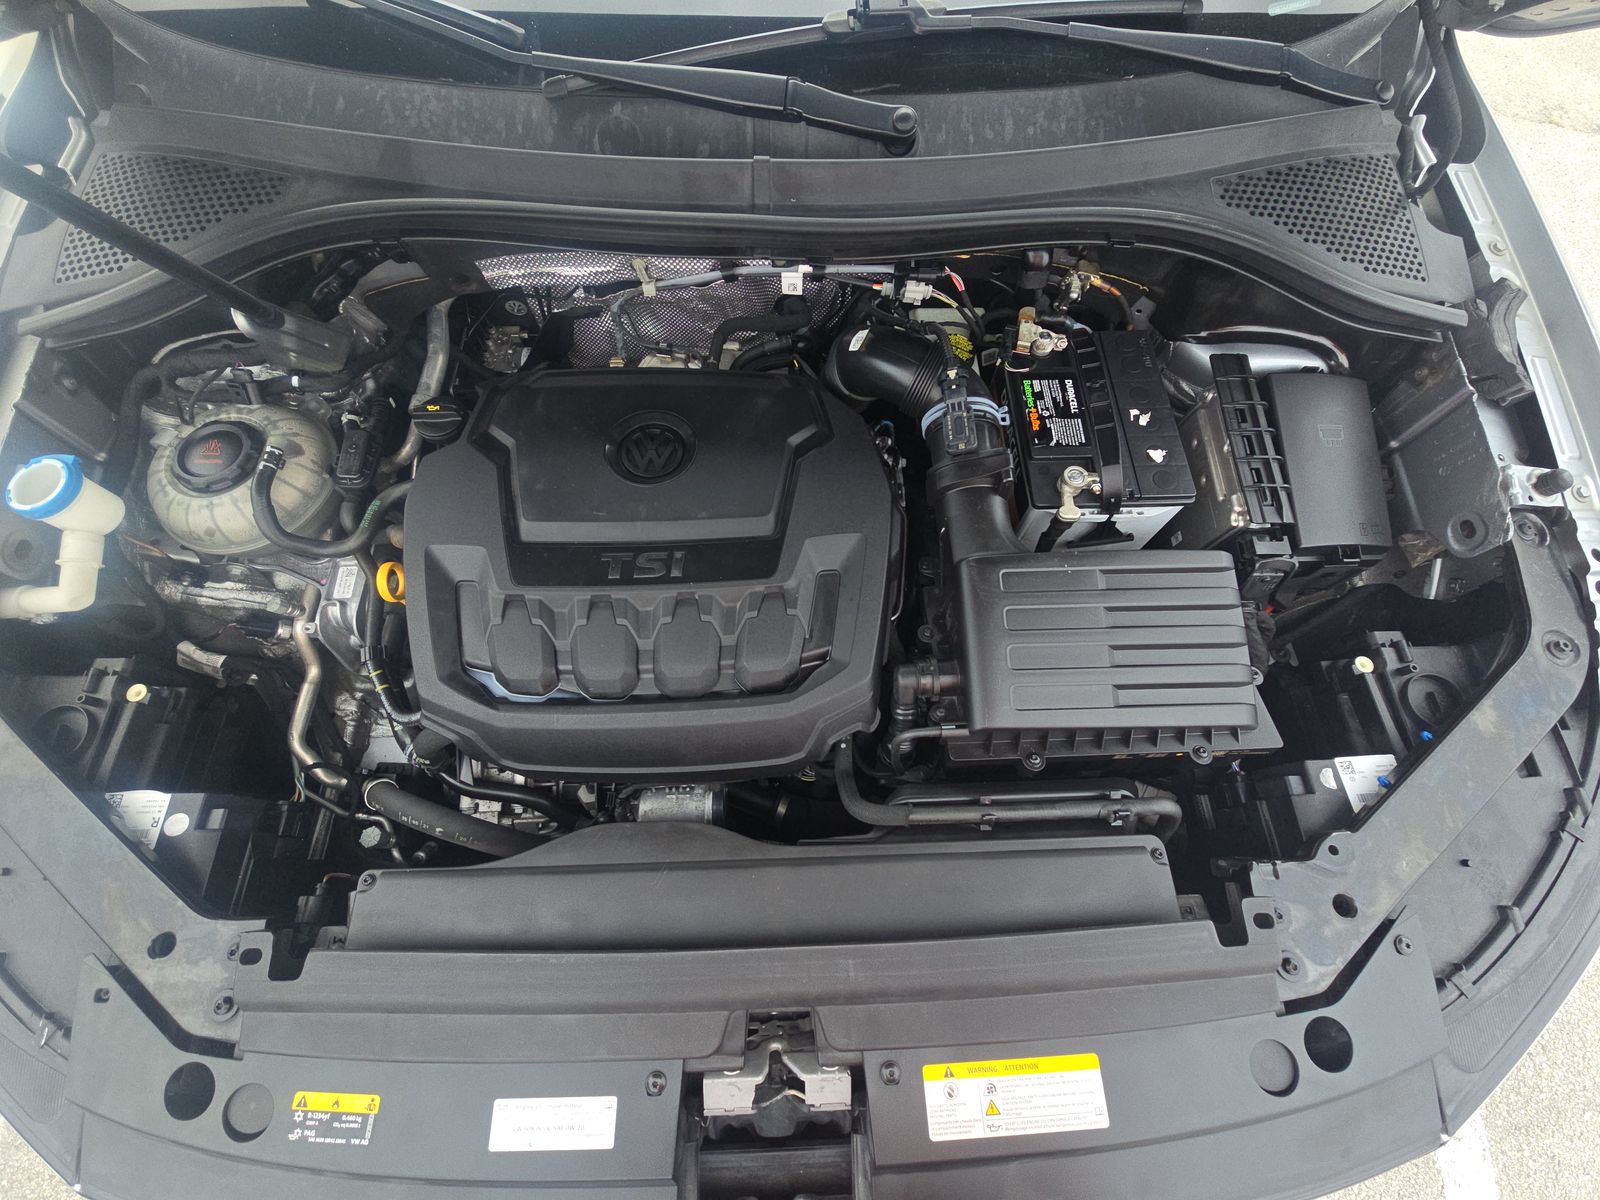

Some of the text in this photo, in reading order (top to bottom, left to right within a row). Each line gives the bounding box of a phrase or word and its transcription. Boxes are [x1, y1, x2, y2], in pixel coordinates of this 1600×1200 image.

[1065, 379, 1079, 413] DURACELL
[621, 424, 684, 476] VW
[601, 551, 687, 579] TSI
[967, 1063, 1039, 1074] WARNING ATTENTION
[303, 1129, 316, 1137] PAG
